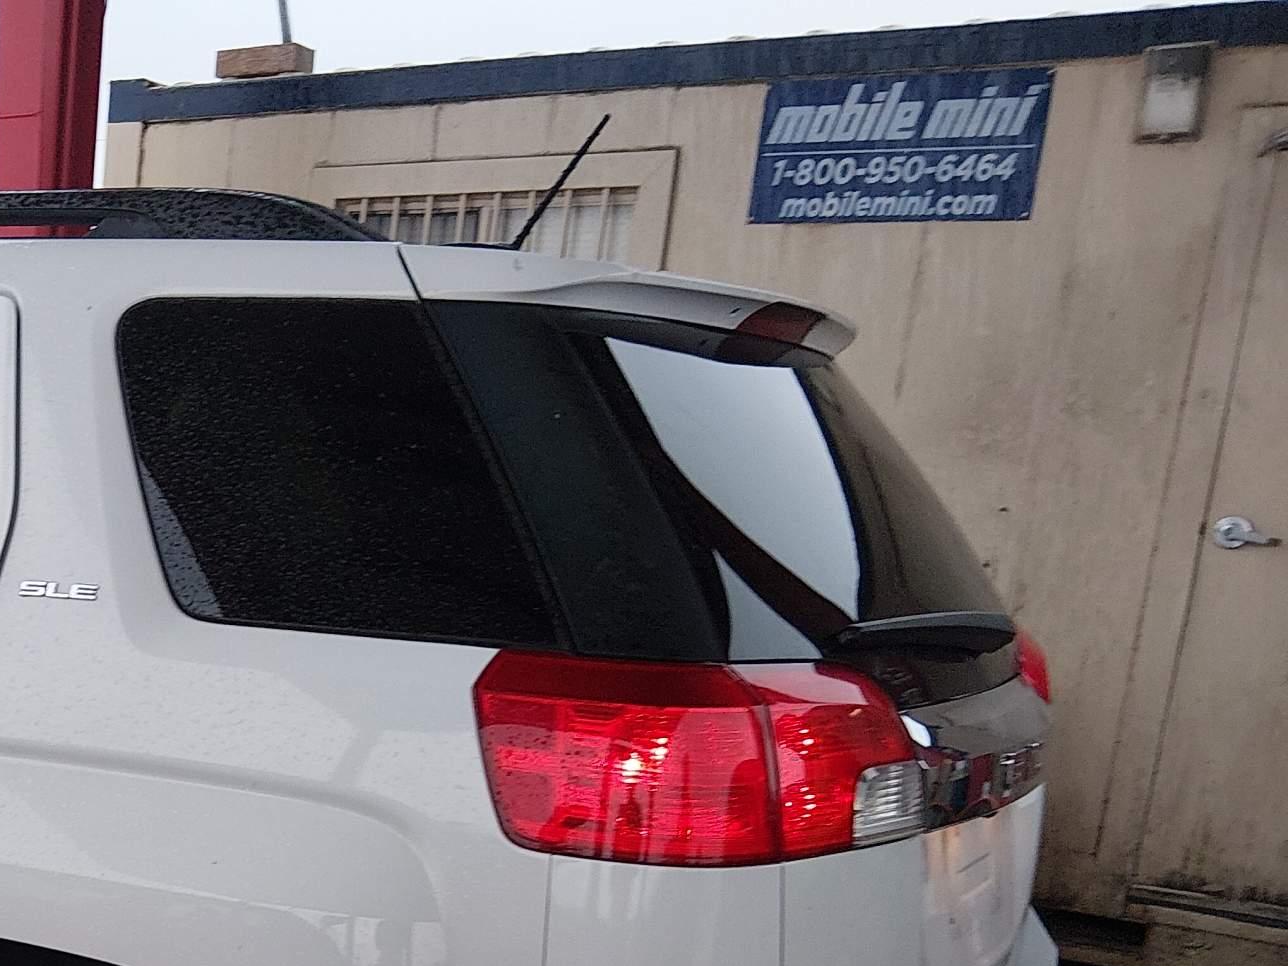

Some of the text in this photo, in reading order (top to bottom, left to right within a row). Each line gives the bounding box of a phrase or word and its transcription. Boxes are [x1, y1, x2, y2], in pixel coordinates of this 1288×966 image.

[765, 81, 1050, 145] mobile mini
[771, 152, 1020, 186] 1-800-950-6464
[778, 189, 999, 218] mobilemini.com
[18, 580, 100, 601] SLE
